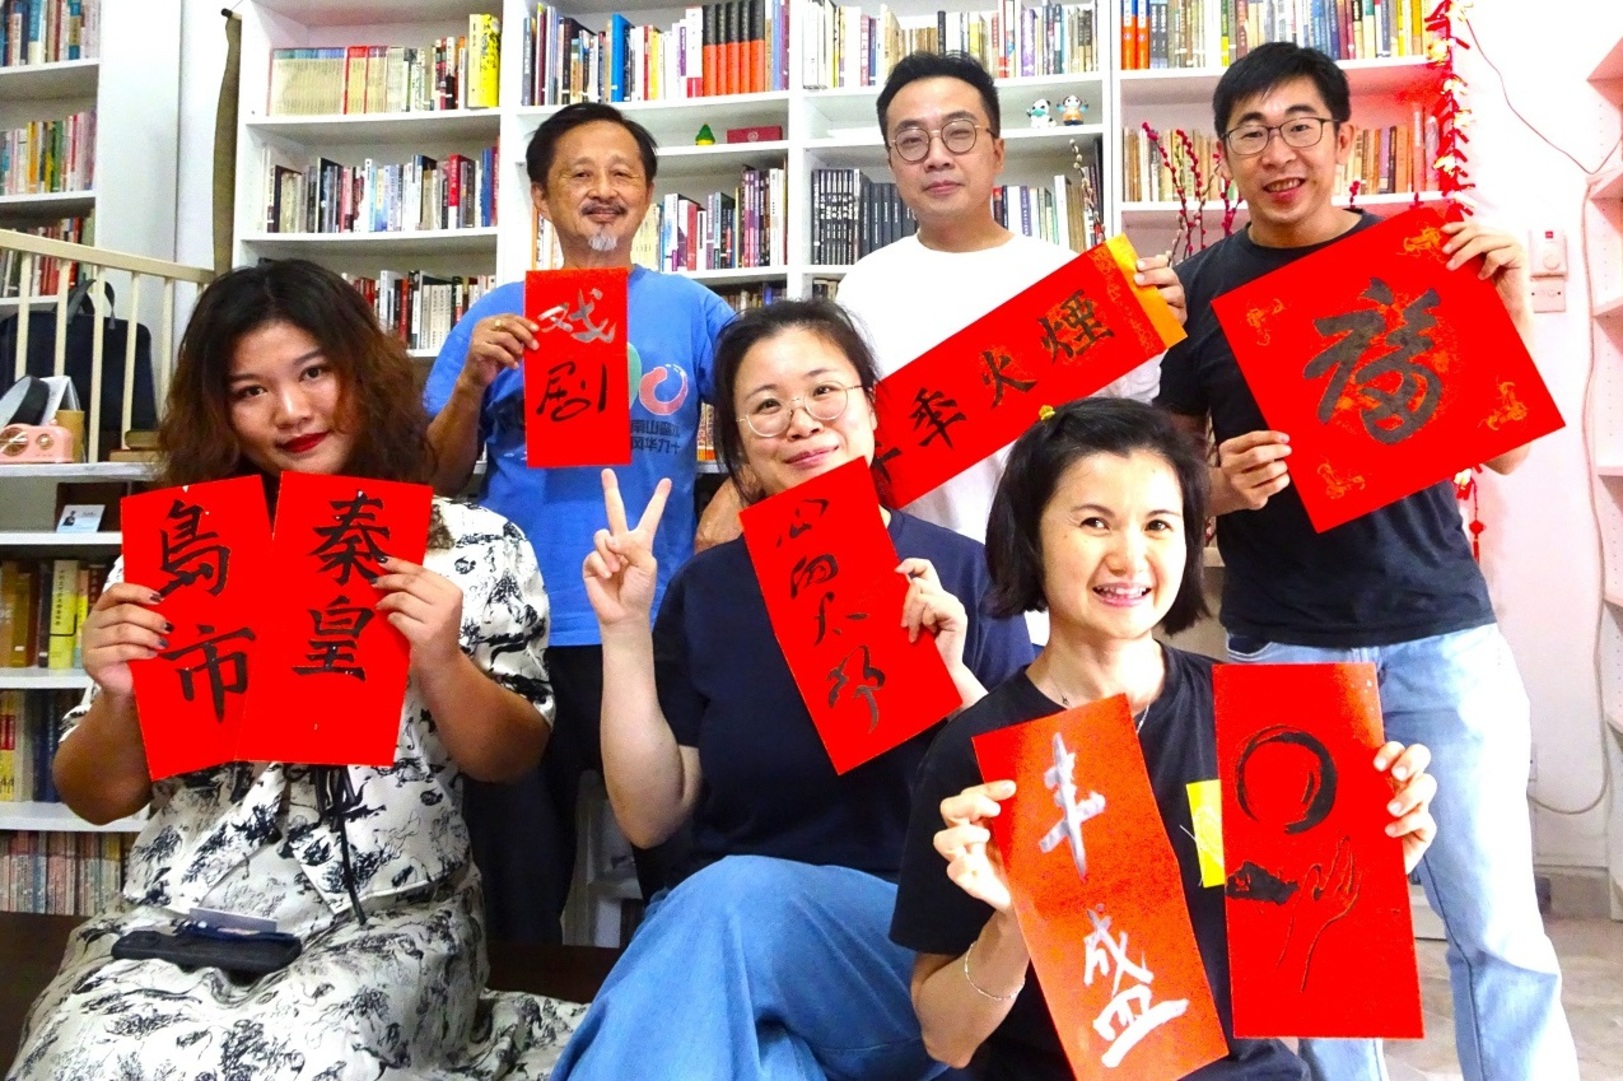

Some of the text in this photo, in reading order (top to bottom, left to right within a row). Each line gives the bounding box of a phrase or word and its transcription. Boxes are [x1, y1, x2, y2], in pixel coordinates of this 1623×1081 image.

[536, 288, 617, 423] 戏剧
[1302, 277, 1442, 444] 福
[291, 491, 391, 683] 秦皇
[1038, 731, 1190, 1069] 丰盛
